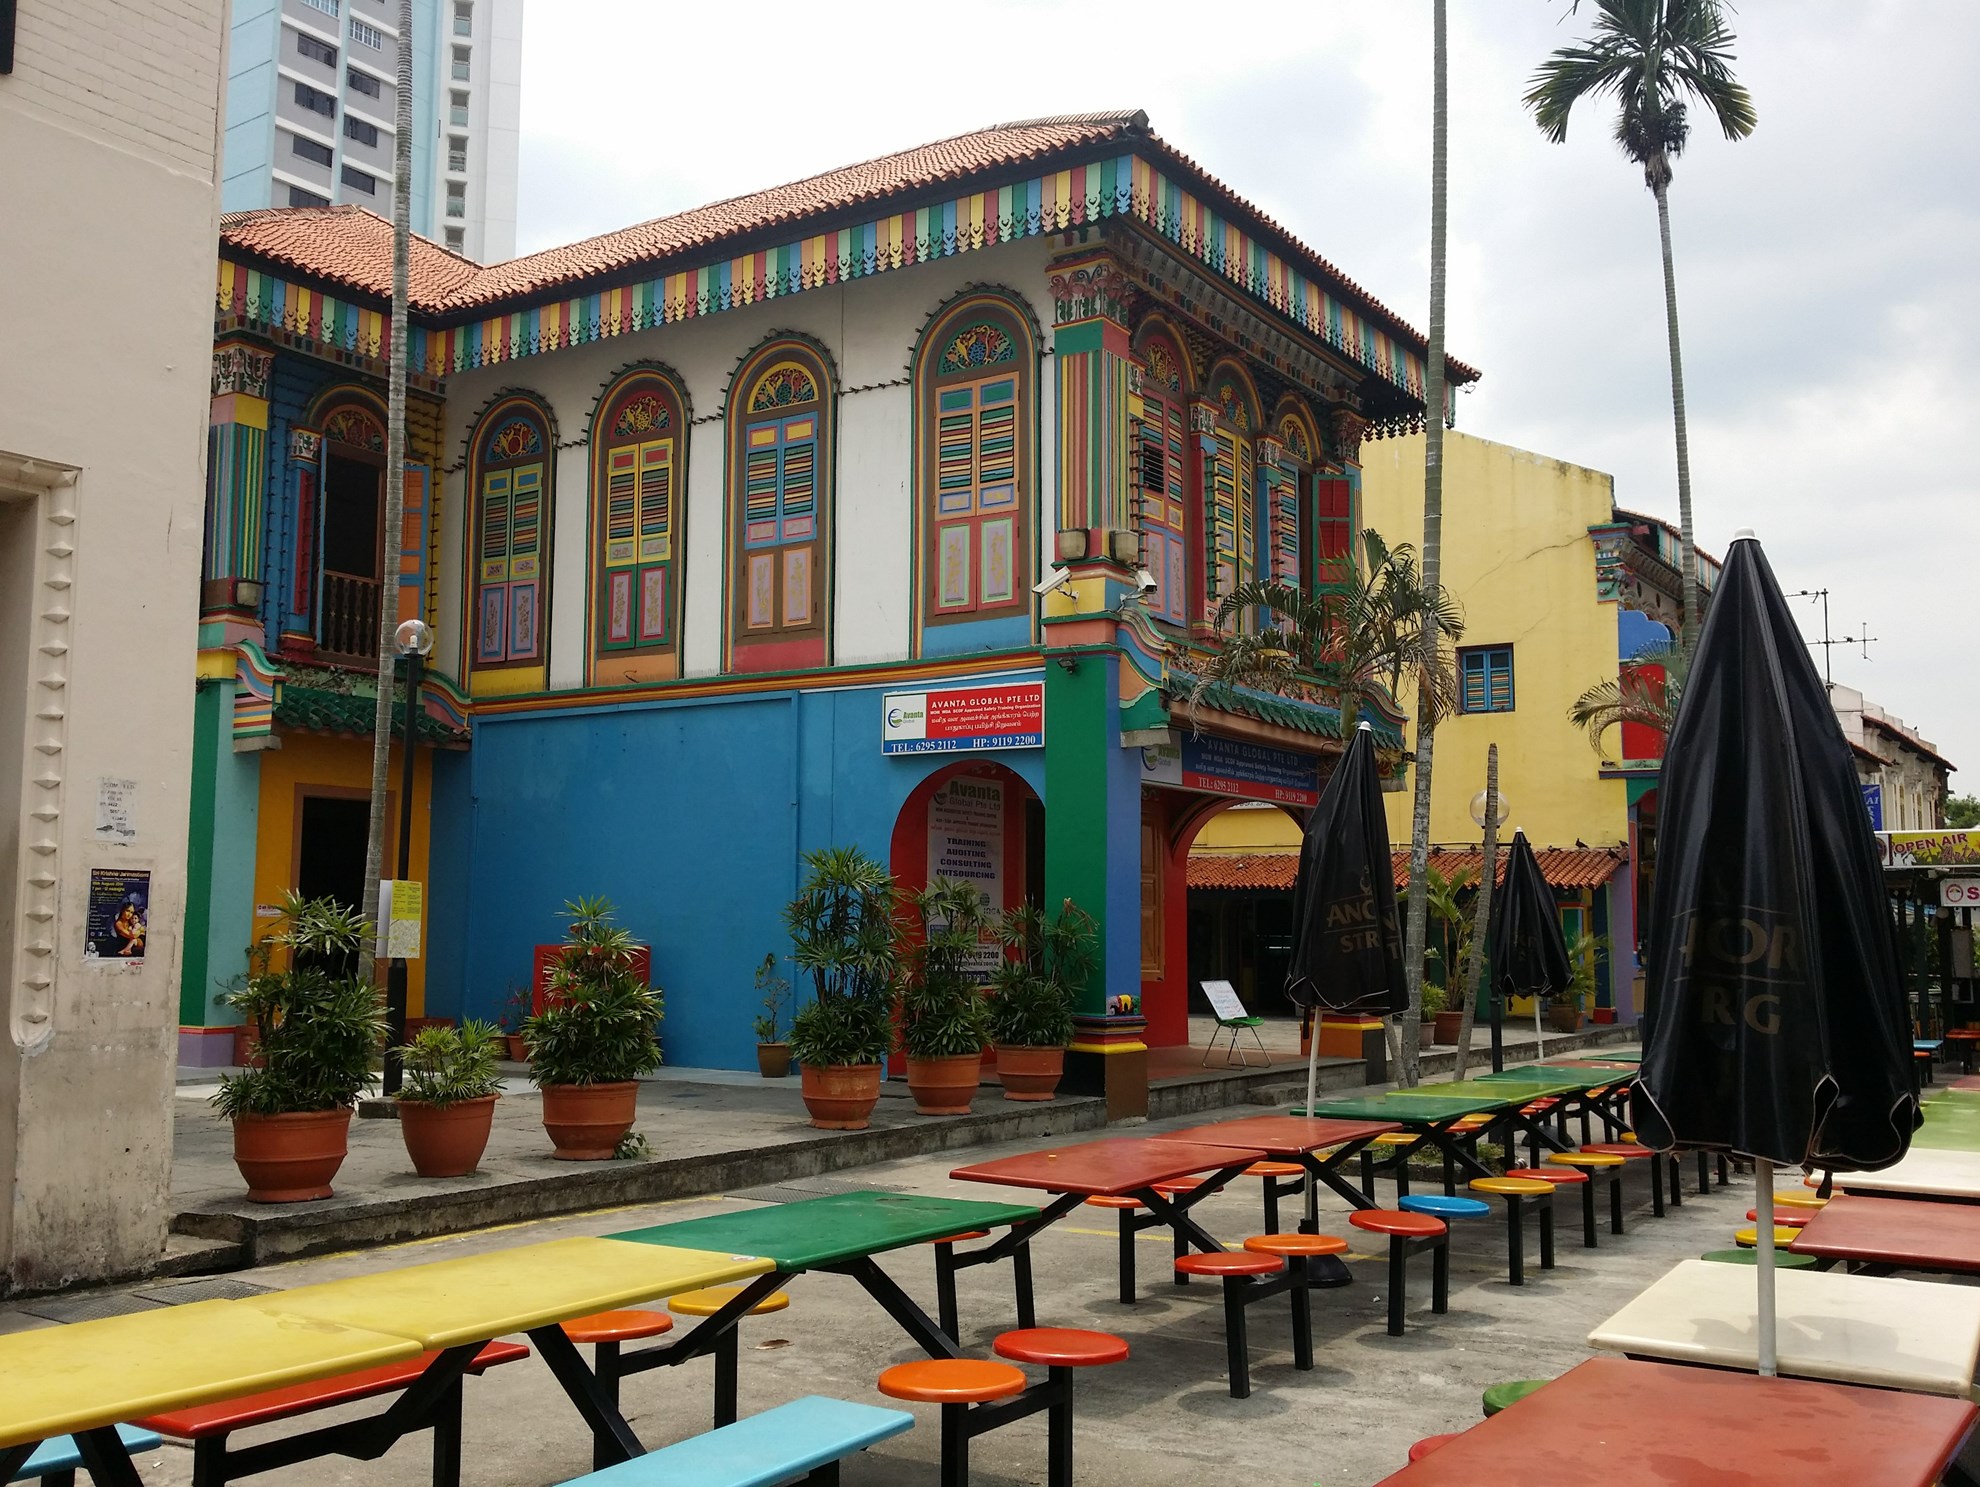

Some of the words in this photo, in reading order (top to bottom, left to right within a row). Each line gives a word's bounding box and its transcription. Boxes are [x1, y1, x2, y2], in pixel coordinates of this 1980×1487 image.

[931, 699, 966, 709] AVANTA
[969, 696, 1003, 706] GLOBAL
[1006, 695, 1021, 703] PTE
[1024, 694, 1040, 702] LTD
[903, 711, 924, 719] Avanta
[891, 743, 914, 752] TEL:
[915, 742, 935, 751] 6295
[937, 740, 957, 750] 2112
[973, 738, 990, 748] HP:
[992, 737, 1013, 747] 9119
[1015, 736, 1036, 746] 2200
[1207, 739, 1239, 755] AVANTA
[1242, 744, 1272, 761] GLOBAL
[1273, 749, 1285, 763] PTE
[1286, 752, 1299, 766] LTD
[949, 780, 1000, 802] Avanta
[1198, 776, 1213, 789] TEL:
[1214, 778, 1227, 791] 6295
[1227, 780, 1239, 793] 2112
[1275, 789, 1285, 800] HP:
[1285, 790, 1296, 802] 9119
[949, 797, 973, 808] Global
[975, 799, 988, 809] Pte
[946, 837, 986, 848] TRAINING
[1894, 838, 1936, 854] OPEN
[1941, 833, 1968, 848] AIR
[946, 848, 986, 858] AUDITING
[940, 858, 992, 869] CONSULTING
[936, 868, 996, 880] OUTSOURCING
[983, 951, 999, 959] 2200
